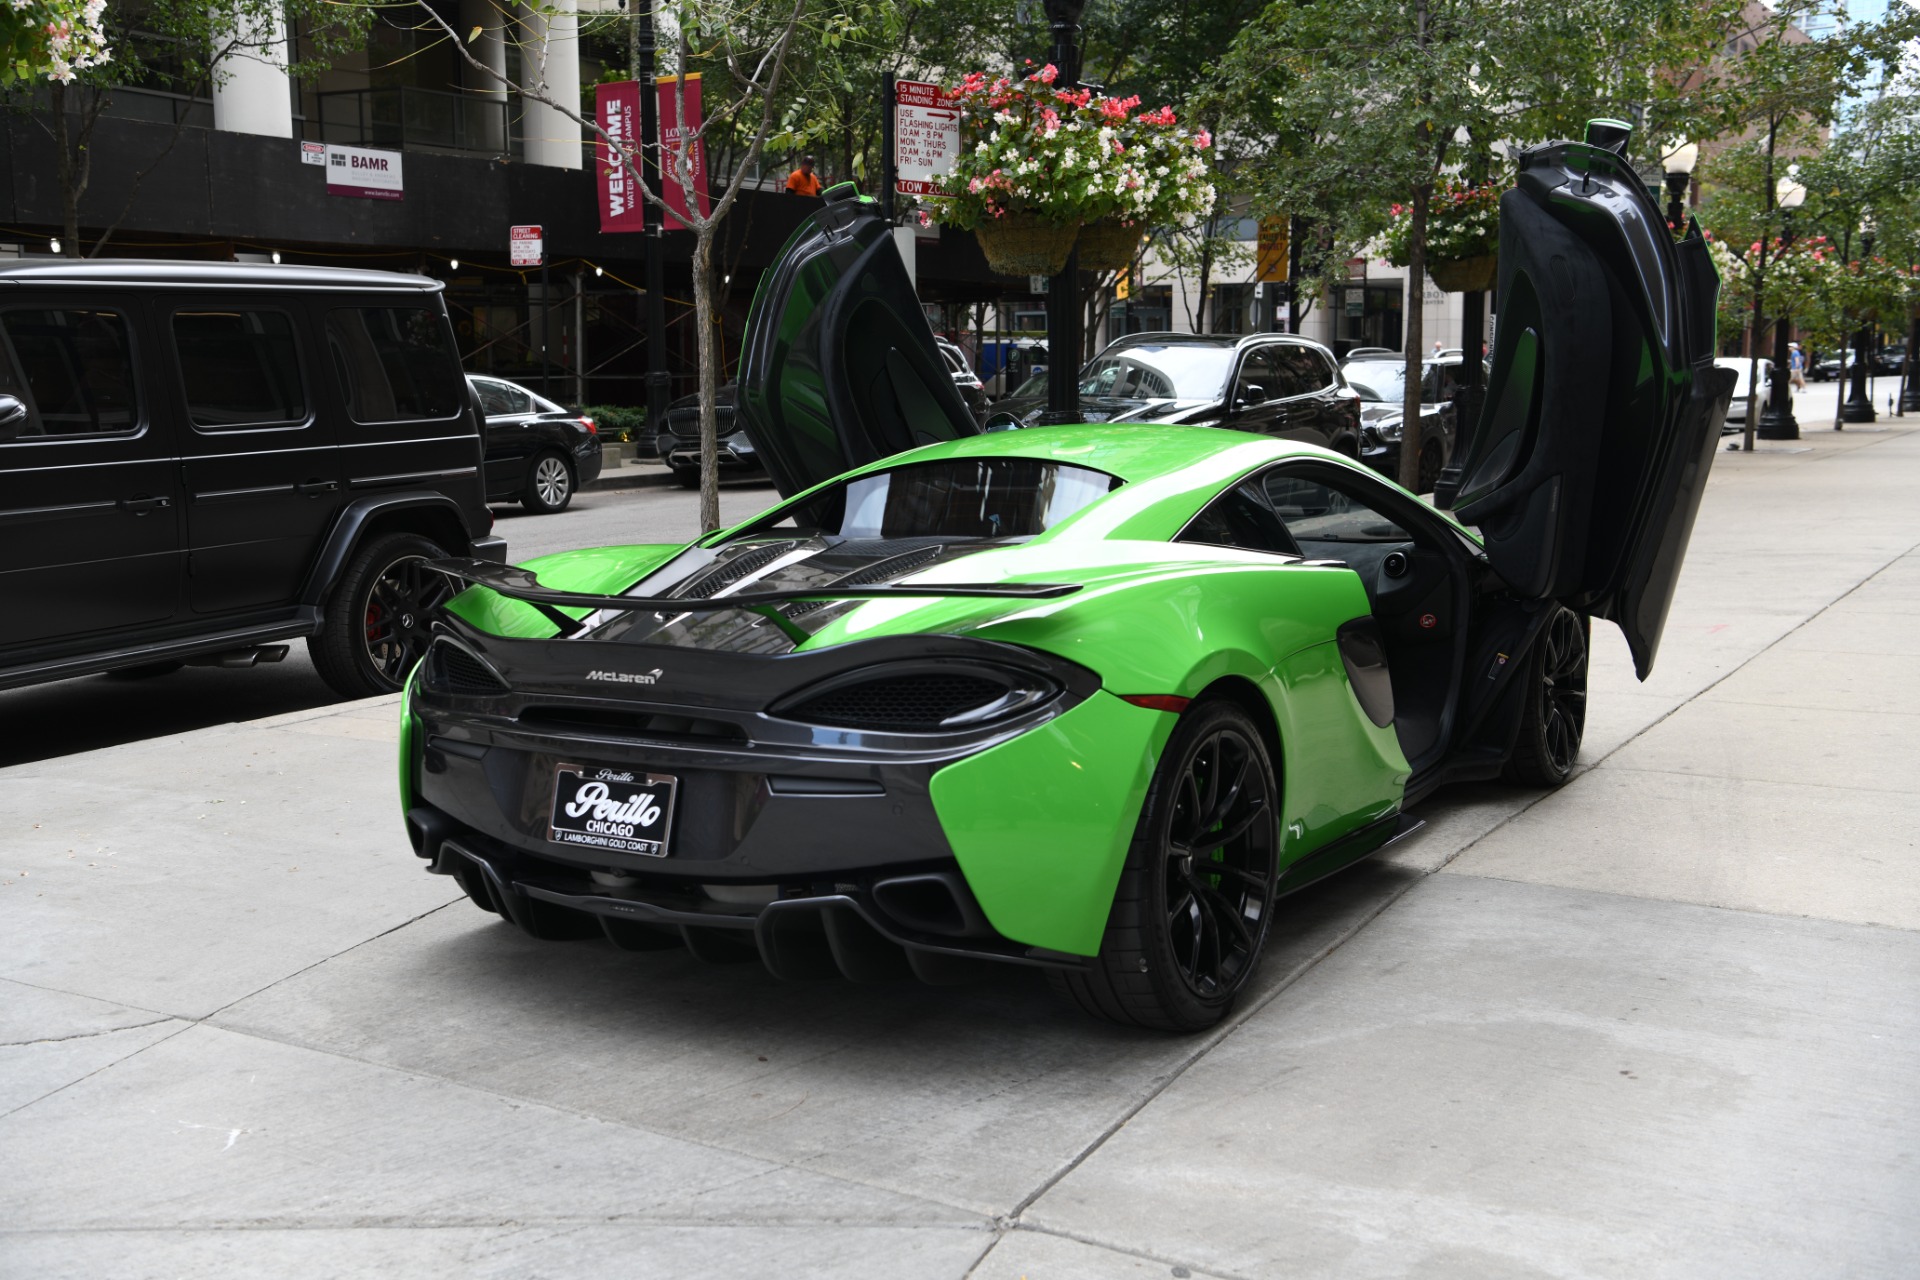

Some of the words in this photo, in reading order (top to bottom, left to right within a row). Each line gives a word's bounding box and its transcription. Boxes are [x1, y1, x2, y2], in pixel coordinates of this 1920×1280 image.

[900, 84, 907, 93] 15
[909, 85, 935, 96] MINUTE
[900, 95, 934, 106] STANDING
[899, 109, 914, 118] USE
[665, 126, 697, 138] LOYLA
[900, 119, 934, 130] FLASHING
[934, 123, 958, 133] LIGHTS
[900, 128, 908, 136] 10
[908, 129, 920, 137] AM
[926, 131, 931, 139] 8
[933, 131, 944, 139] PM
[900, 137, 916, 146] MON
[923, 139, 947, 150] THURS
[606, 99, 625, 218] WELCOME
[900, 147, 908, 156] 10
[908, 148, 919, 157] AM
[926, 150, 931, 158] 6
[932, 151, 943, 159] PM
[351, 155, 389, 171] BAMR
[900, 156, 912, 165] FRI
[918, 157, 933, 167] SUN
[626, 178, 635, 209] WATER
[900, 181, 923, 193] TOW
[585, 670, 656, 685] McLaren
[595, 769, 634, 782] Perillo
[565, 781, 661, 827] Perillo
[586, 820, 634, 837] CHICAGO
[564, 833, 609, 846] LAMBORGHINI
[609, 839, 627, 849] GOLD
[627, 841, 649, 852] COAST
